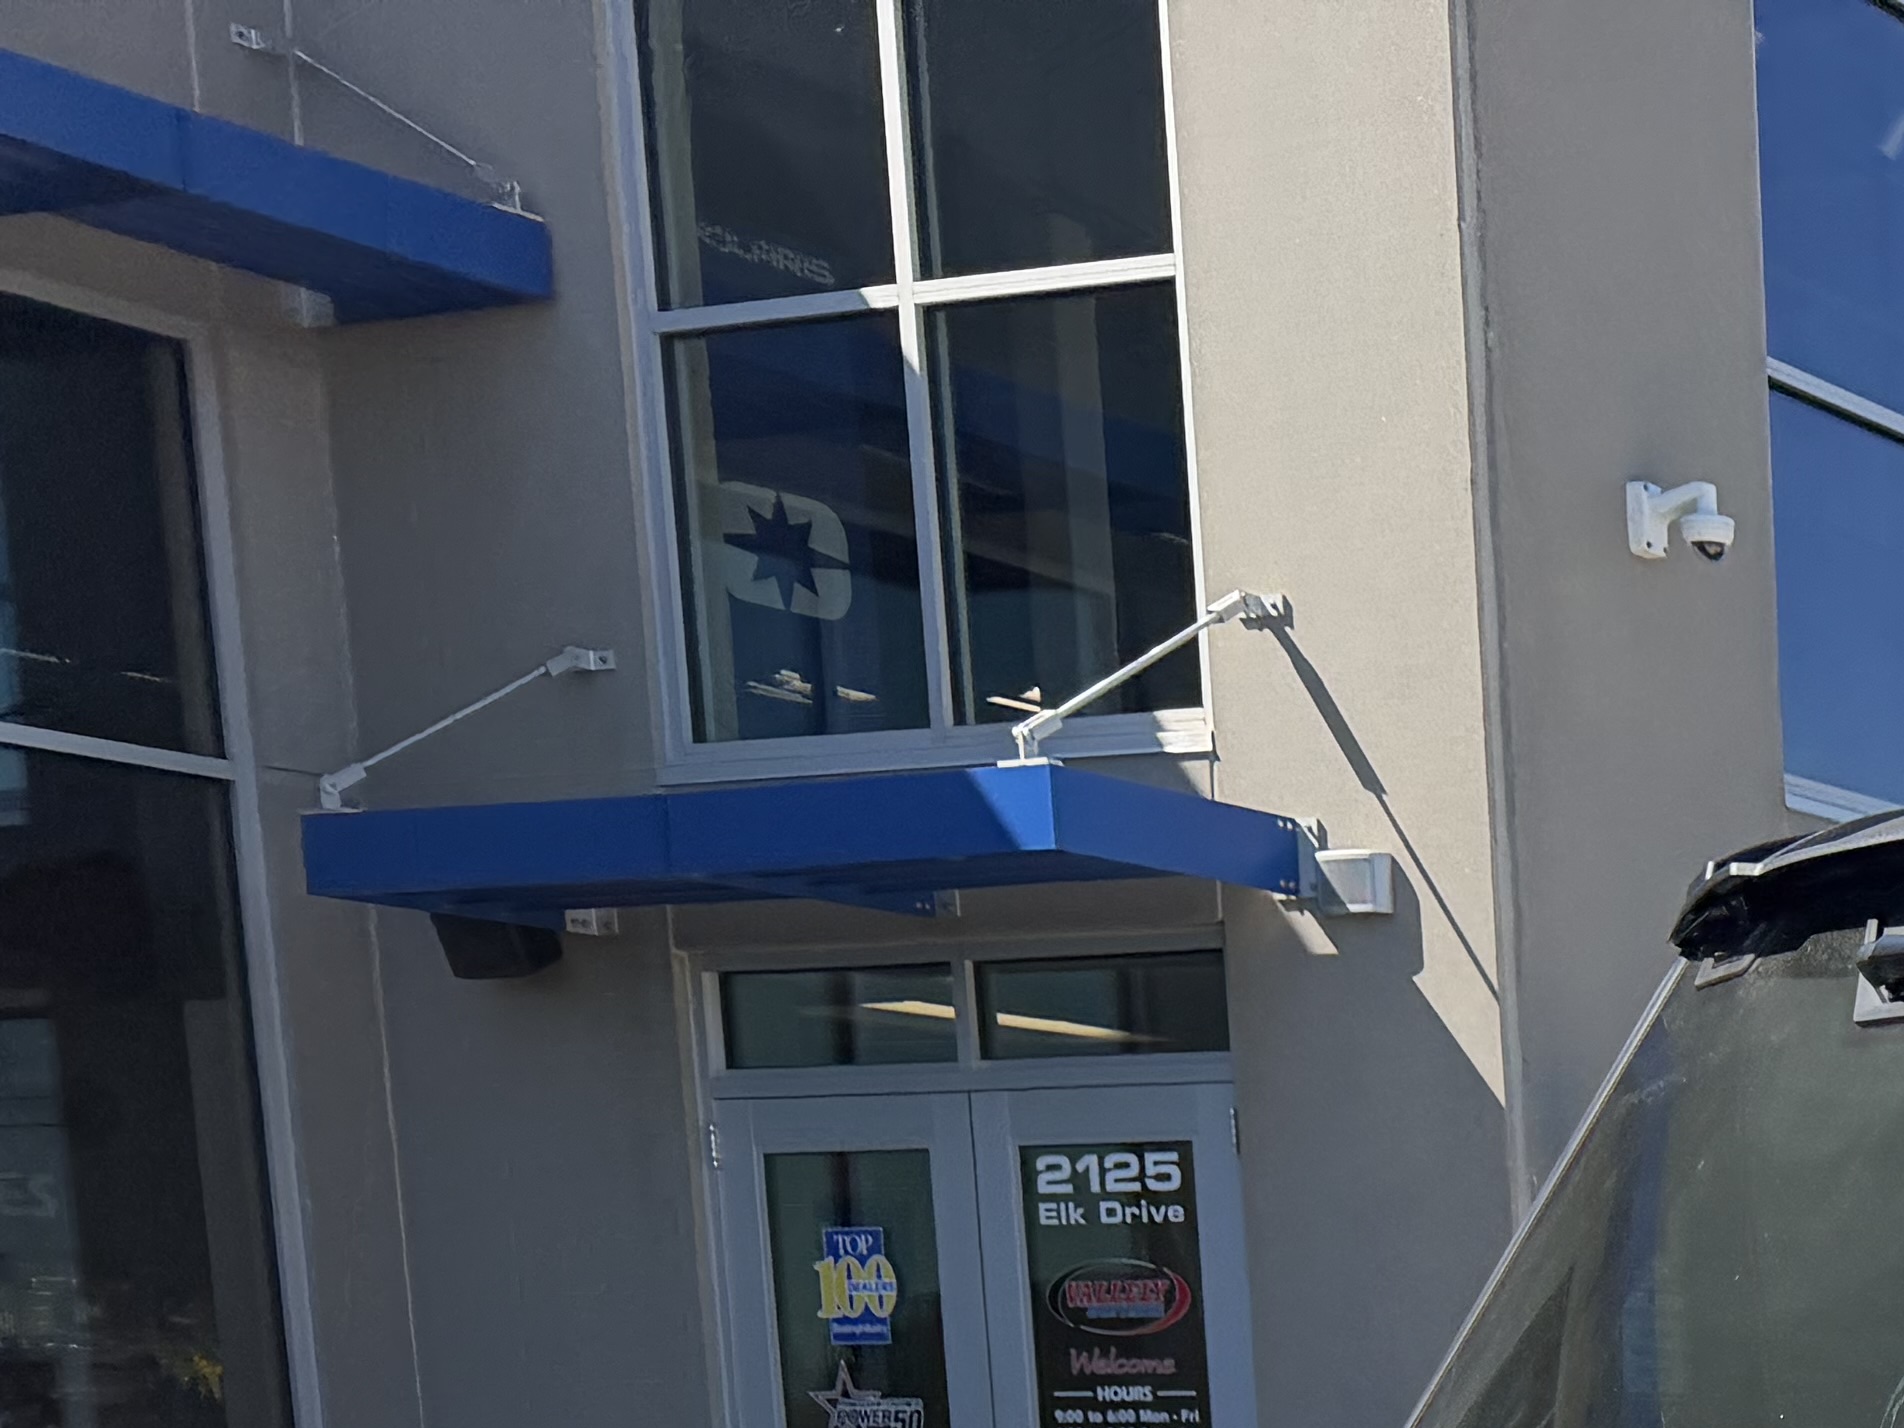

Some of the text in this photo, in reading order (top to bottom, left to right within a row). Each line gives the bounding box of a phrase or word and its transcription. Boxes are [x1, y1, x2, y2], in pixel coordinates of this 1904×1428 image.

[1035, 1151, 1182, 1195] 2125
[1038, 1199, 1186, 1226] Elk Drive
[833, 1234, 874, 1256] TOP
[813, 1254, 898, 1319] 100
[1069, 1345, 1177, 1377] Welcome
[1096, 1385, 1154, 1403] HOURS
[1087, 1409, 1104, 1424] to
[1139, 1408, 1171, 1423] Mon
[1180, 1407, 1200, 1424] Fri
